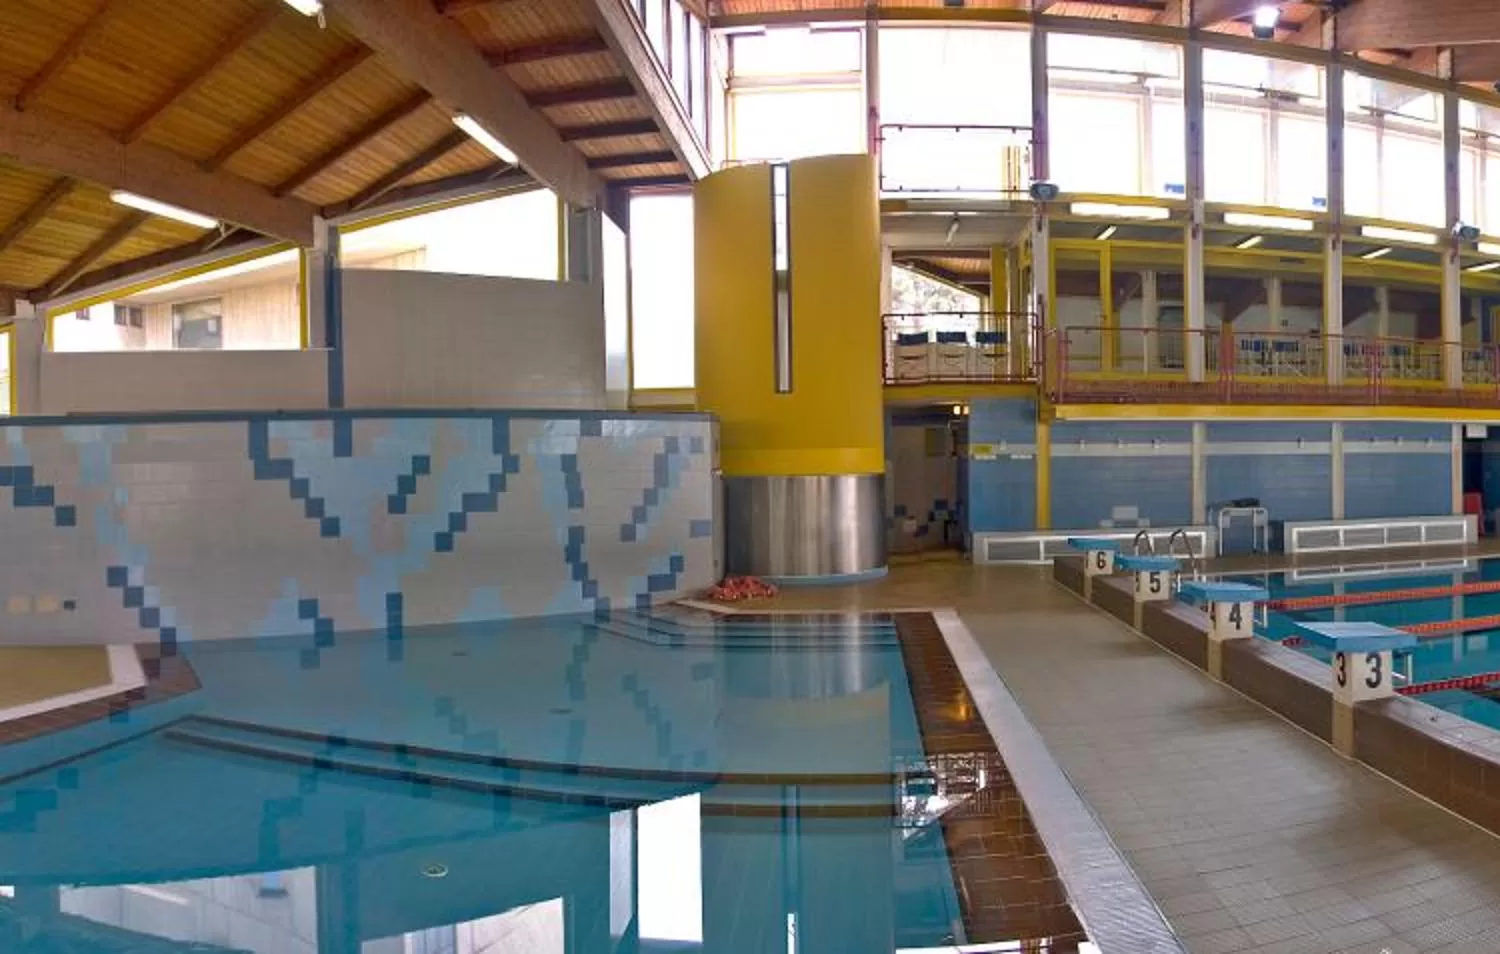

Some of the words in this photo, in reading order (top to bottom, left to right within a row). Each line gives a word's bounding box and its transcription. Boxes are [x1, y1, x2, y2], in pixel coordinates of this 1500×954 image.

[1096, 551, 1107, 570] 6
[1148, 571, 1162, 593] 5
[1228, 603, 1243, 631] 4
[1336, 651, 1347, 688] 3
[1365, 652, 1383, 689] 3
